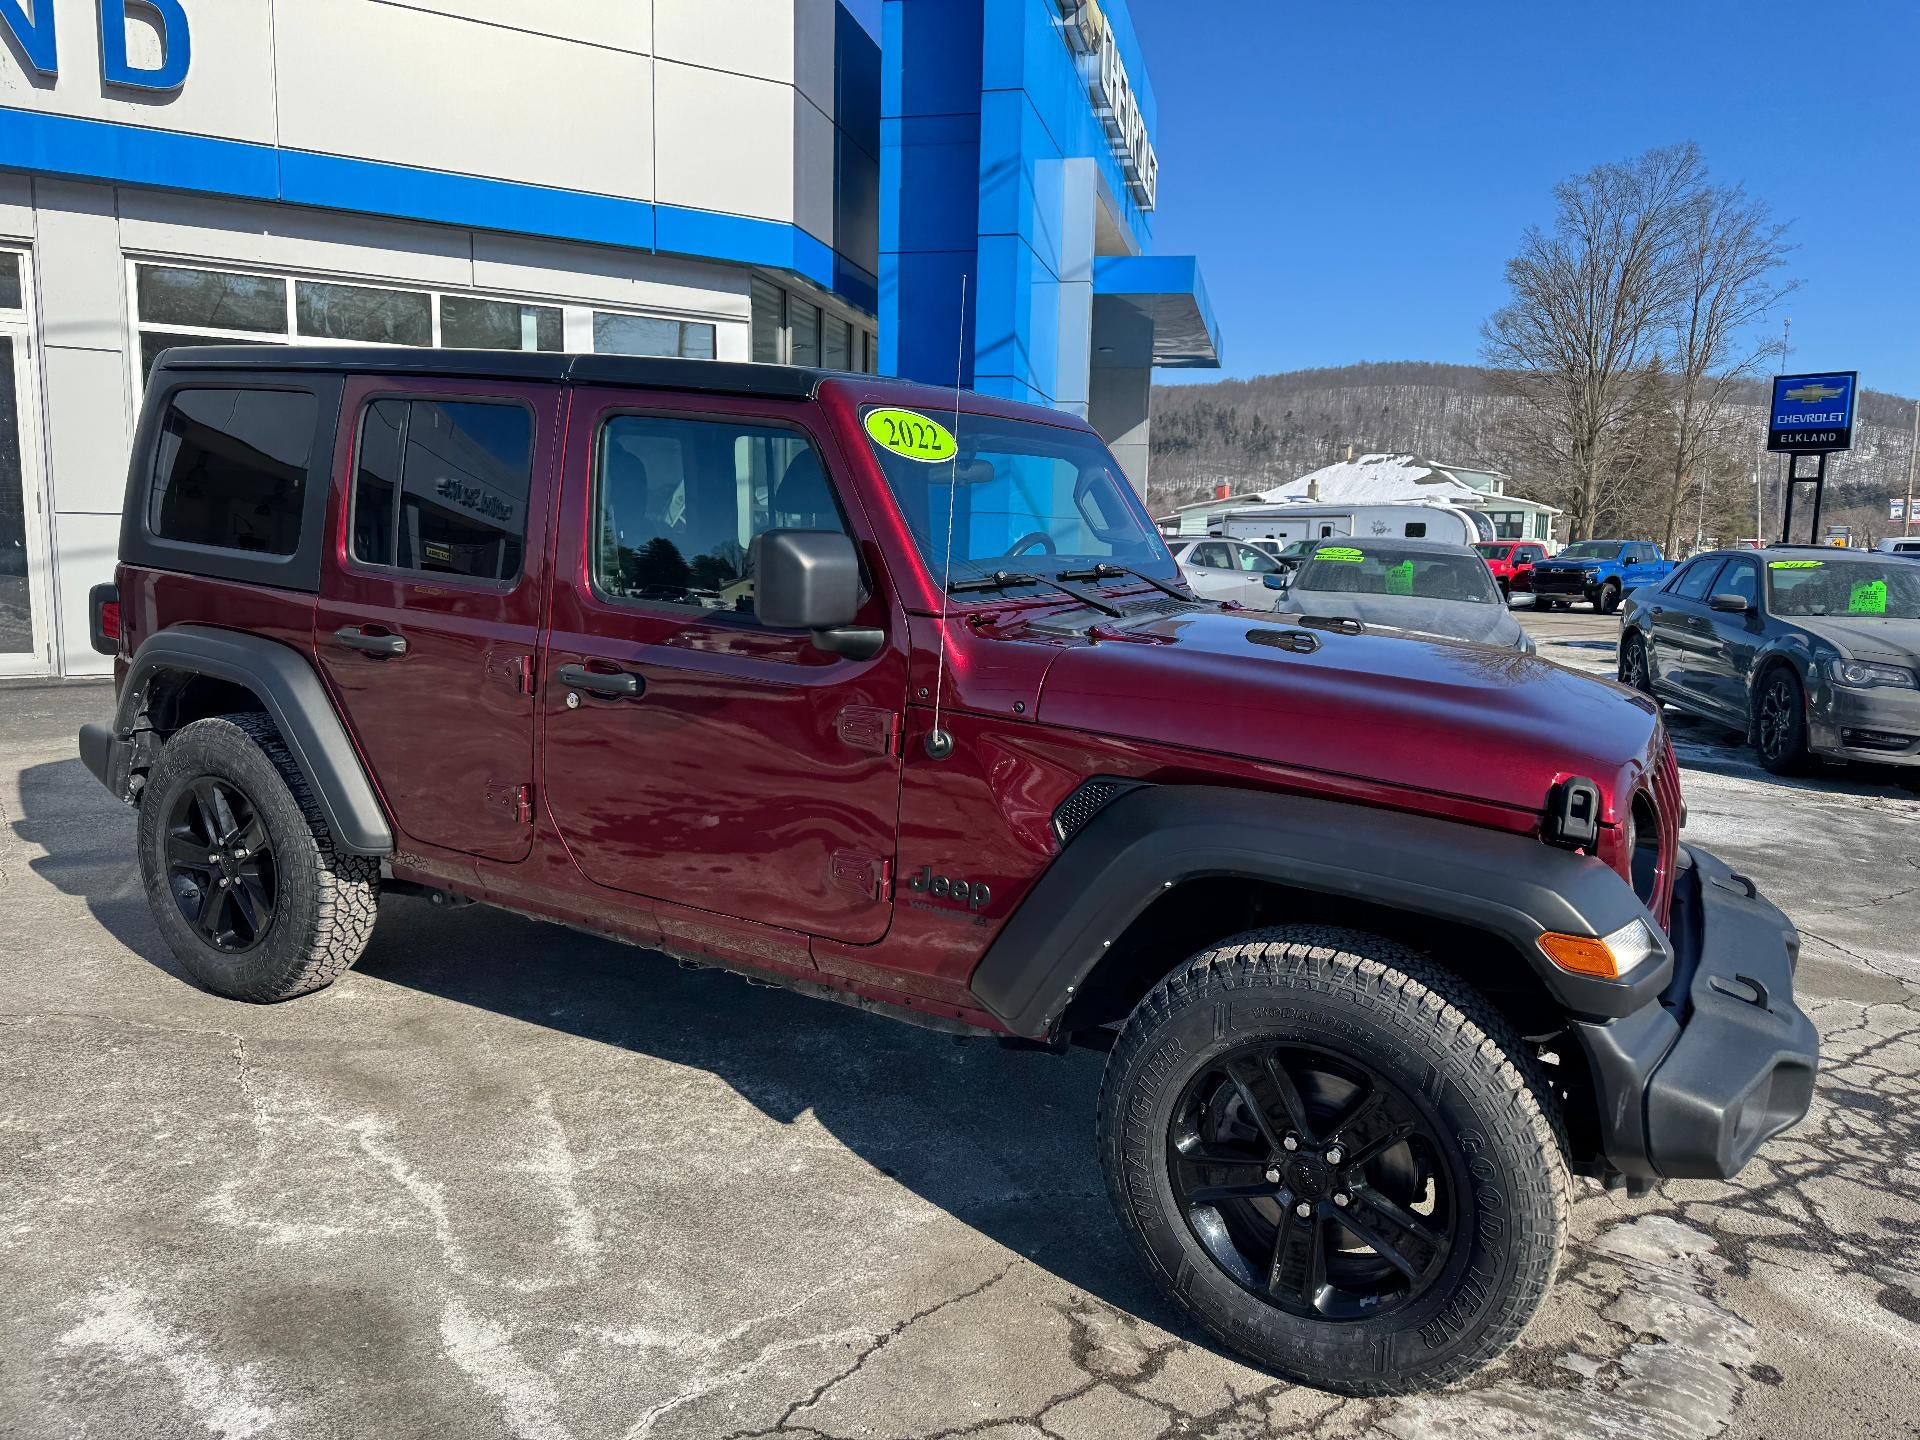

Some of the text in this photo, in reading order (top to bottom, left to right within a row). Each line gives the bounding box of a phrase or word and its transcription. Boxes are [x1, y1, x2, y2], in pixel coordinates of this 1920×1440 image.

[883, 417, 942, 451] 2022
[1777, 412, 1844, 424] CHEVROLET
[1780, 433, 1837, 443] ELKLAND
[911, 865, 991, 910] Jeep
[1125, 1037, 1188, 1232] WRANGLER
